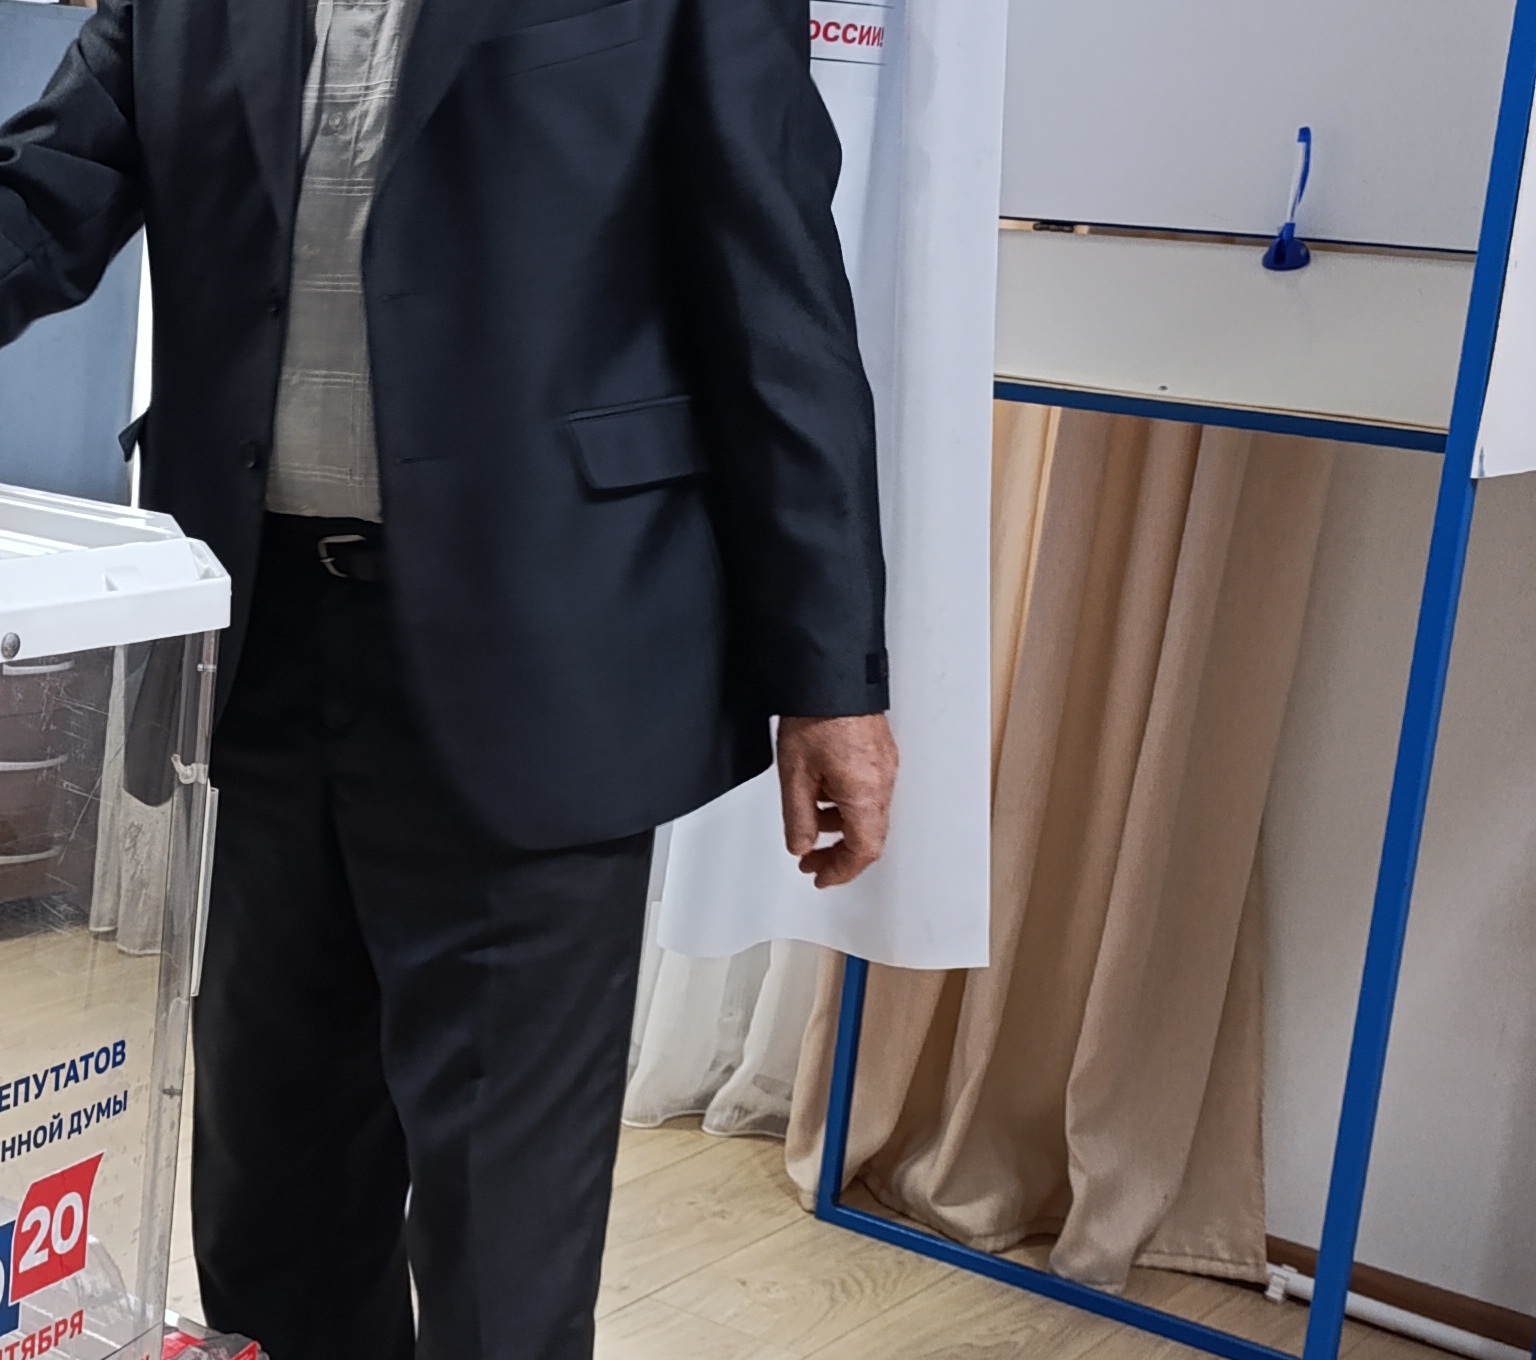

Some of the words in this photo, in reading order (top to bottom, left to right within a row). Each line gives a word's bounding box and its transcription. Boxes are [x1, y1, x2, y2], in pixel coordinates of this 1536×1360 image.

[810, 19, 885, 48] ОССИИ!
[66, 1090, 128, 1140] ДУМЫ
[18, 1191, 84, 1274] 20
